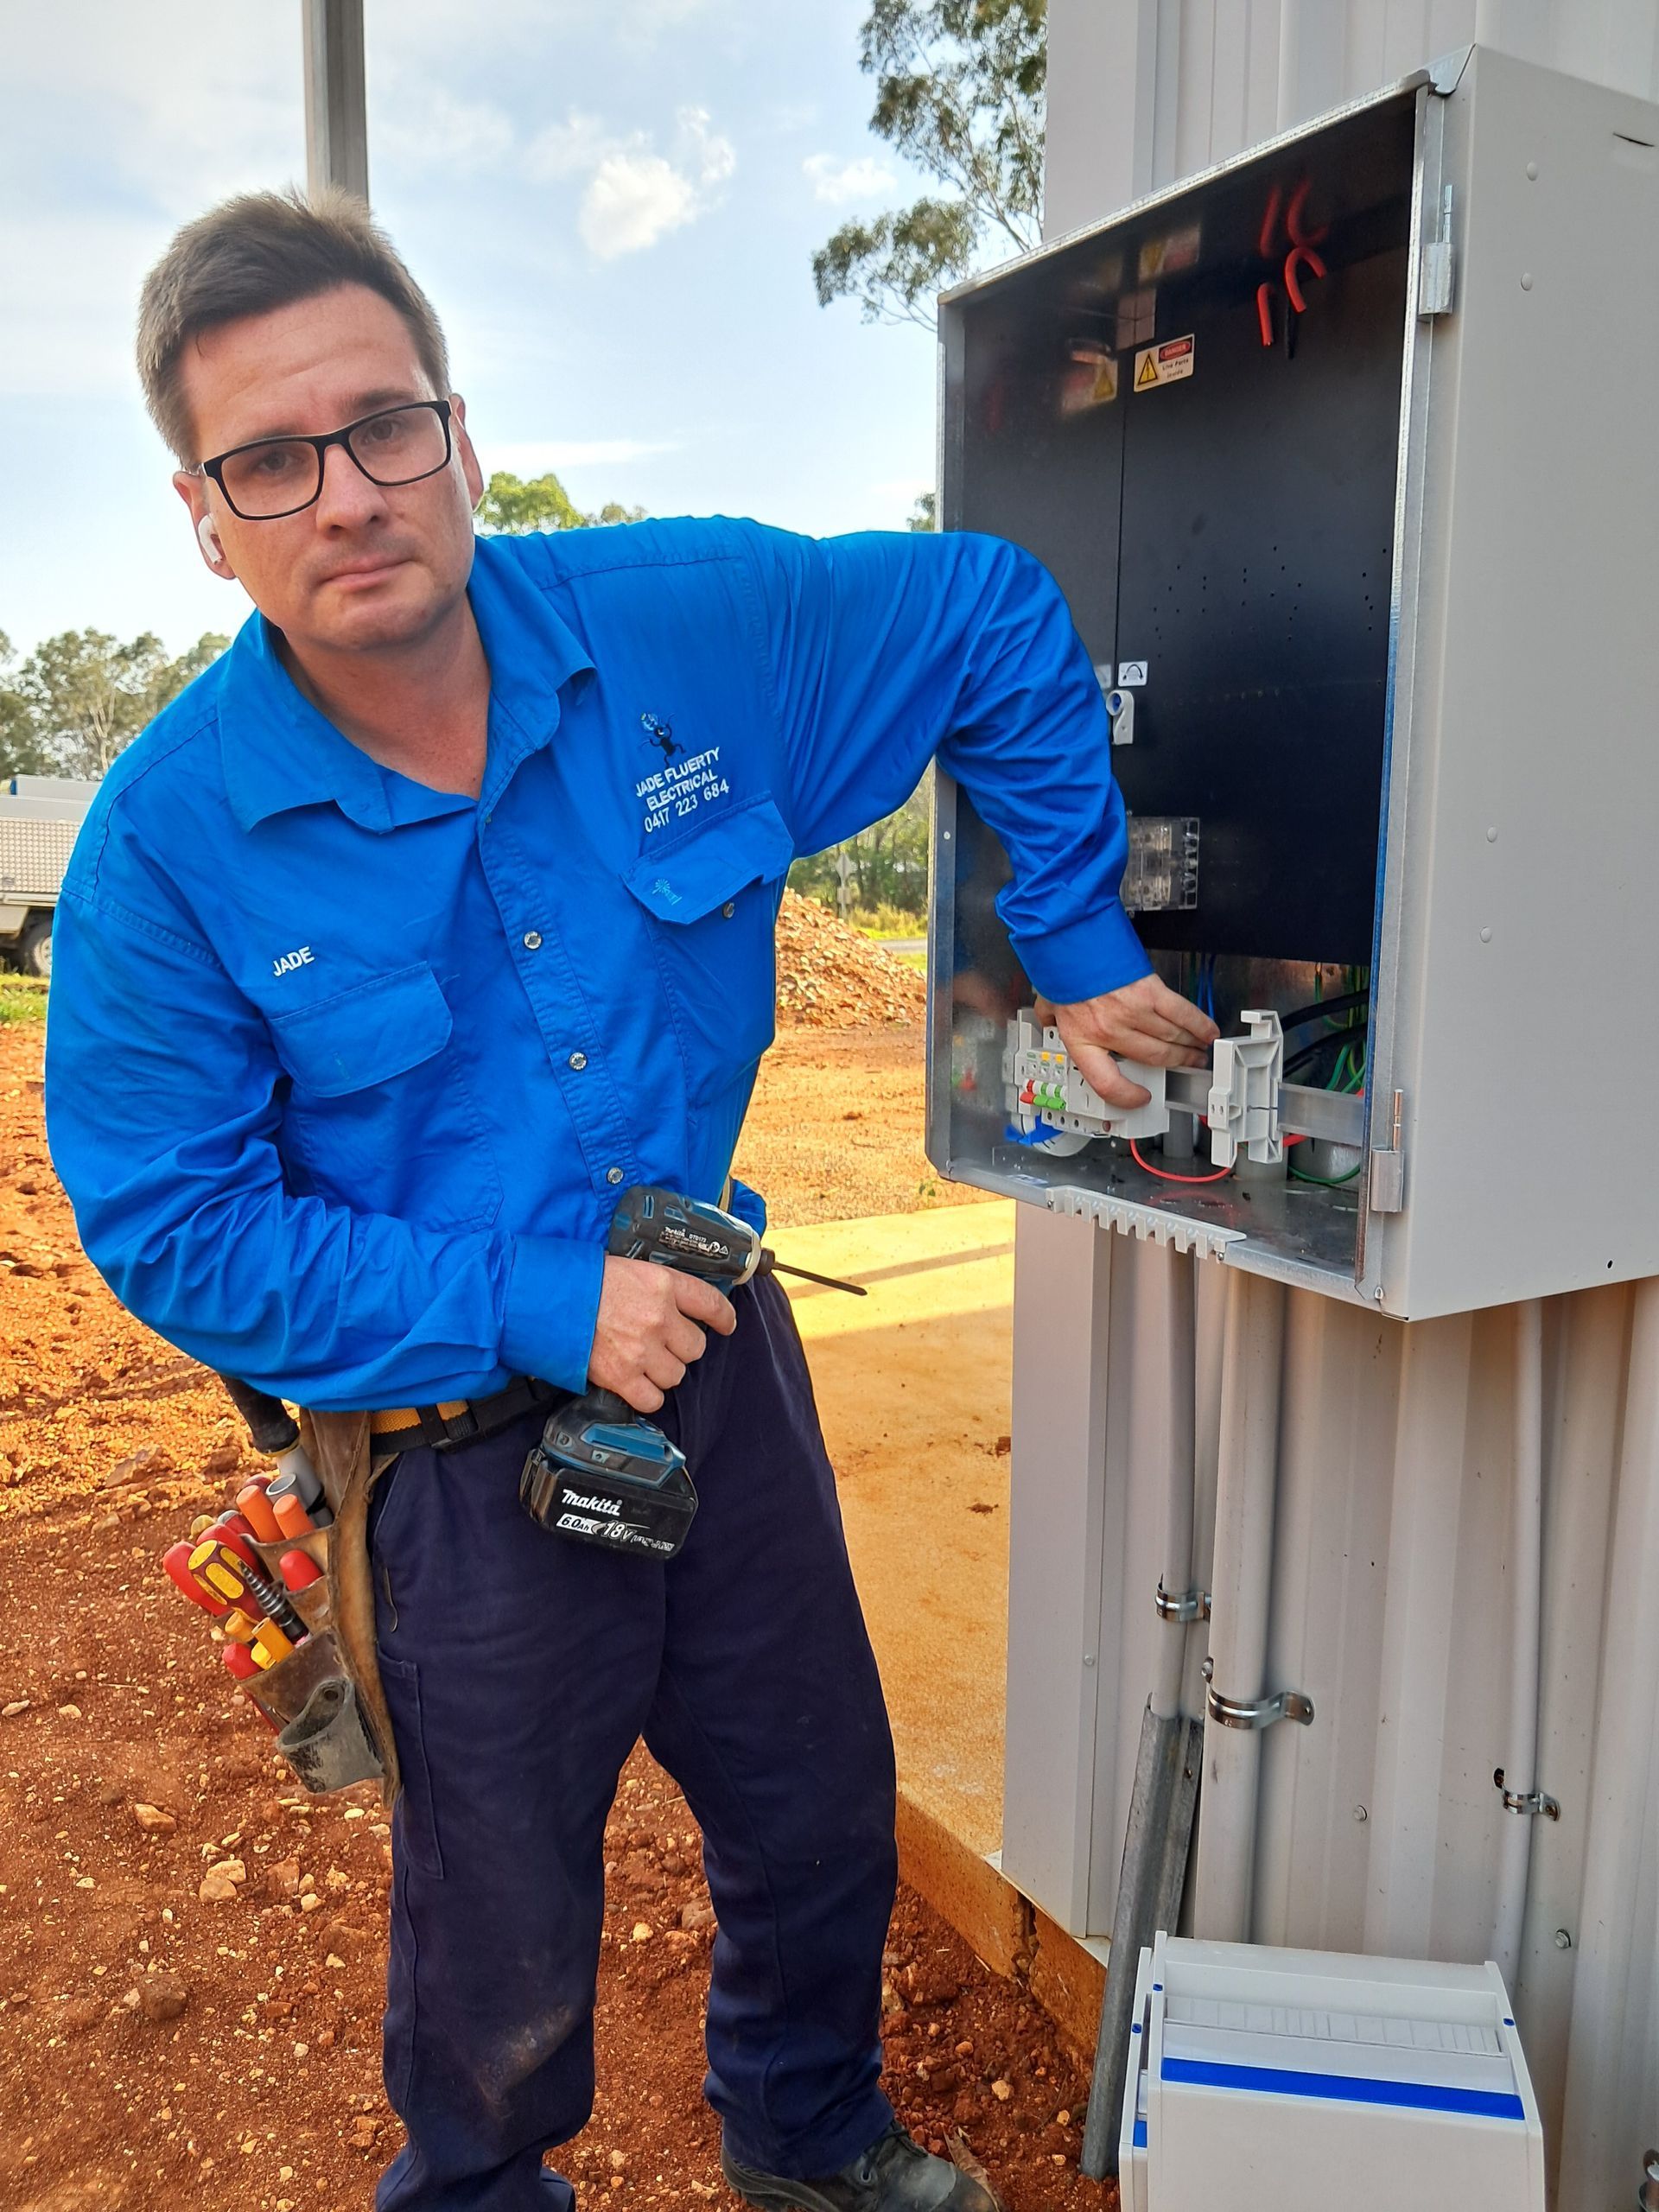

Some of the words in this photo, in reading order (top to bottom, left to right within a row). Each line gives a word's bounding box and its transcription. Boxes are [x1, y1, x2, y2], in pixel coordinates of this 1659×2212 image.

[636, 773, 665, 797] JADE
[664, 747, 720, 784] FLUERTY
[646, 769, 718, 811] ELECTRICAL
[645, 807, 669, 832] 0417
[675, 794, 698, 817] 223
[703, 779, 729, 800] 684
[273, 946, 315, 976] JADE
